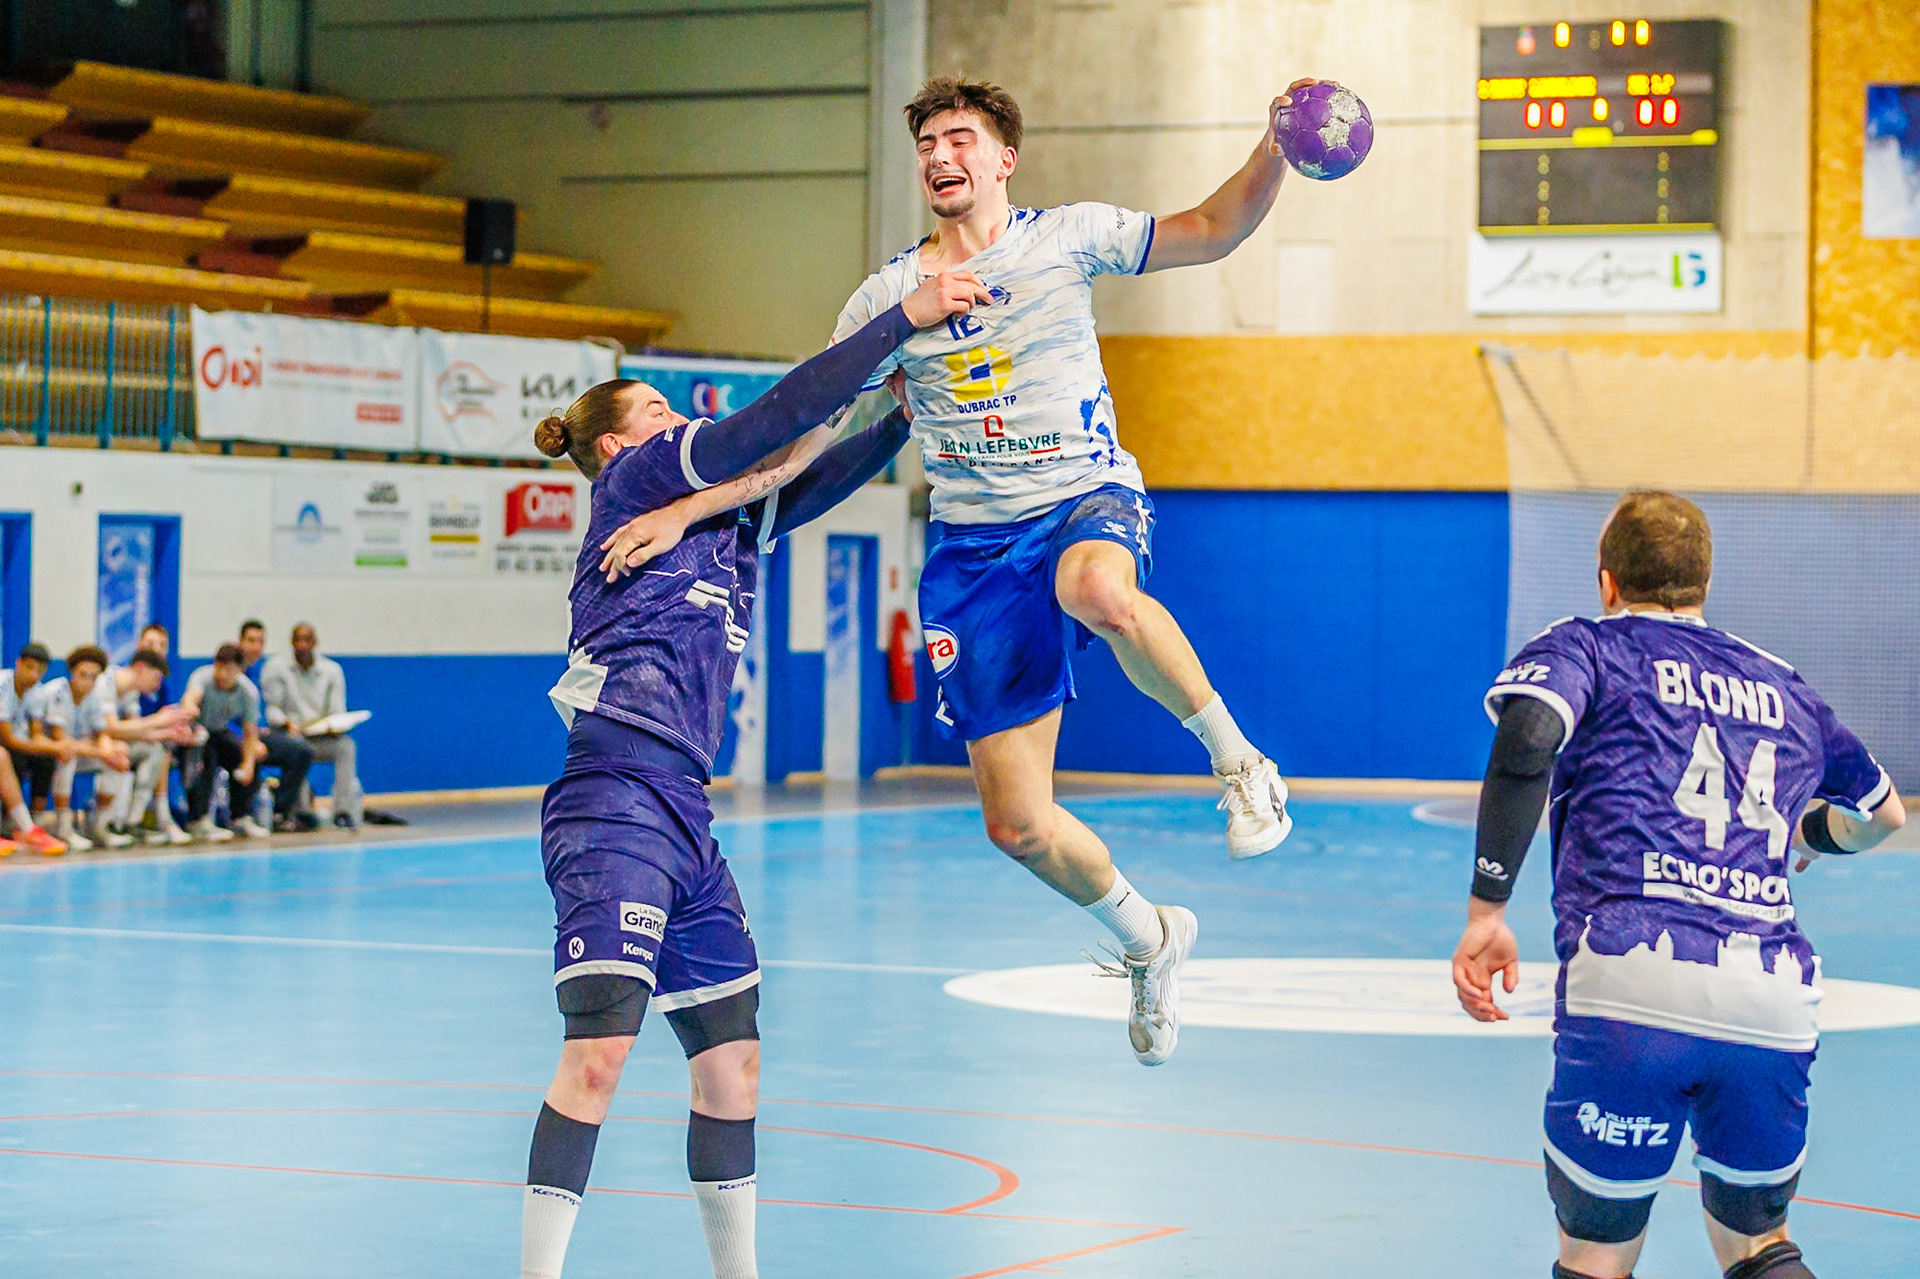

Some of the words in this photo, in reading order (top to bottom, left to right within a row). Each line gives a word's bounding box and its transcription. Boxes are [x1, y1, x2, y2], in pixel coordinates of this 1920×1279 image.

[957, 398, 1000, 414] DUBRAC
[1002, 394, 1018, 408] TP
[976, 432, 1061, 454] LEFEBVRE
[1653, 658, 1785, 730] BLOND
[1672, 722, 1789, 860] 44
[1583, 1118, 1670, 1147] METZ
[1635, 1116, 1652, 1125] DE
